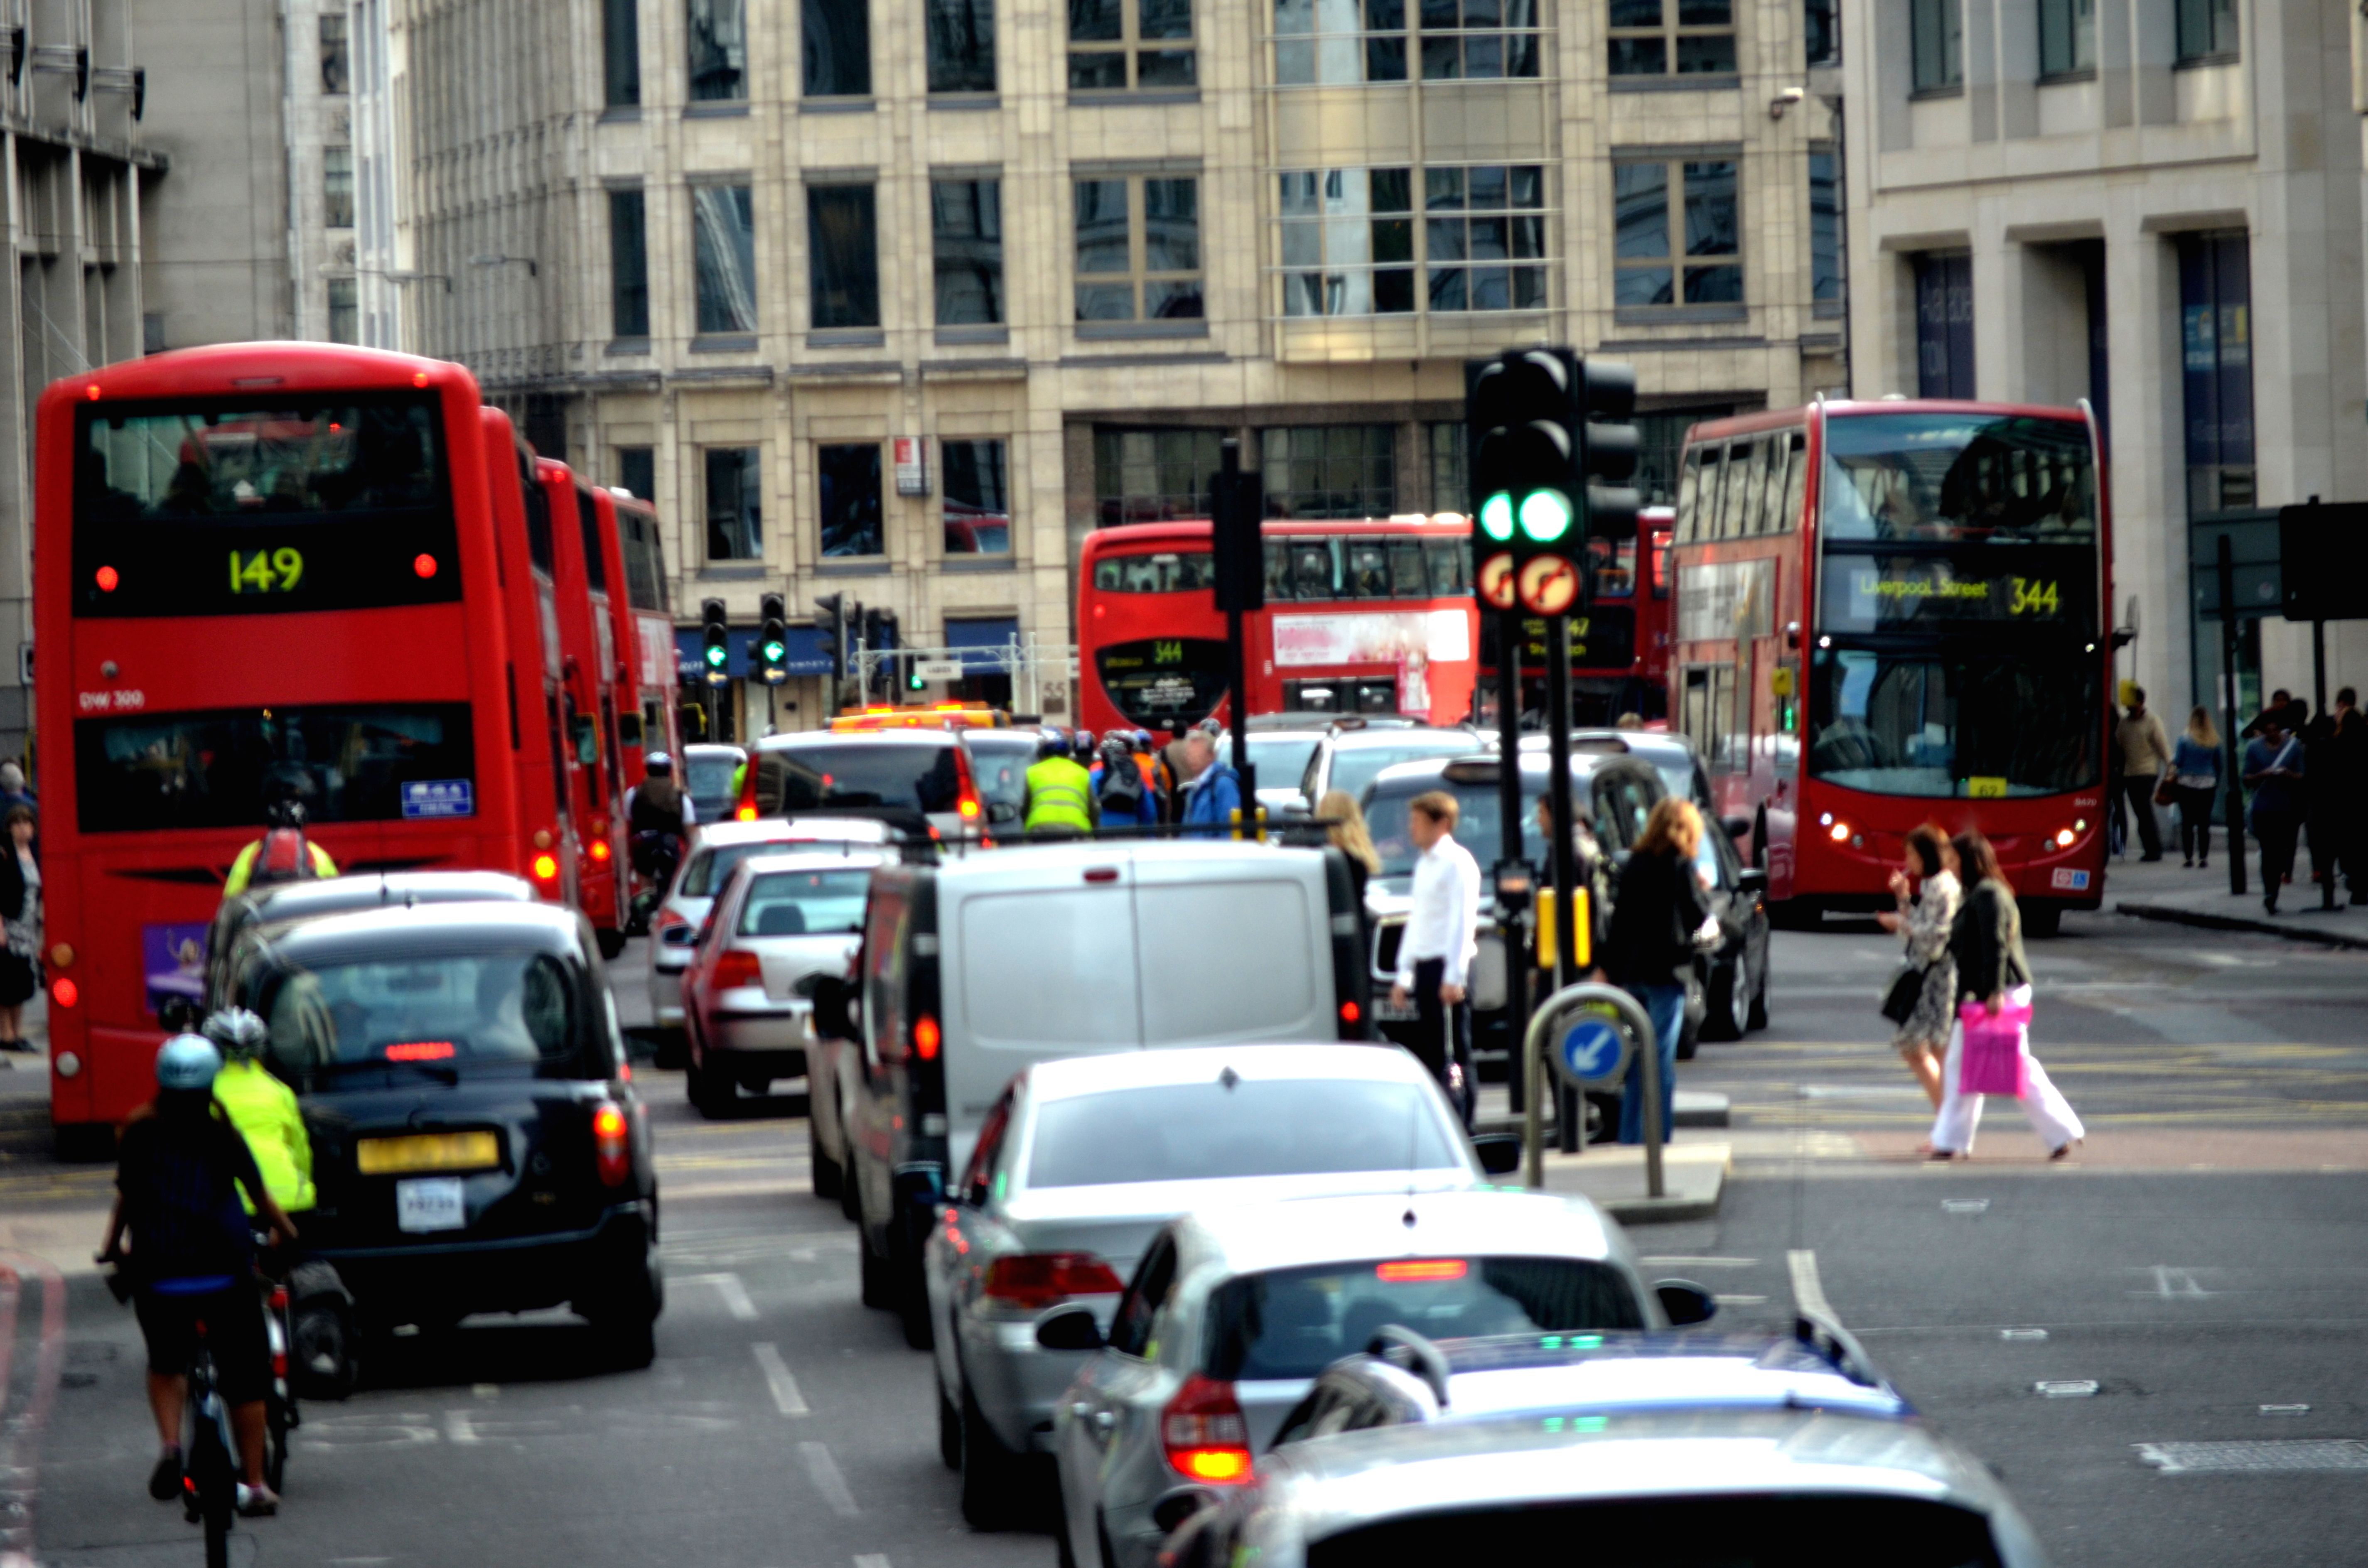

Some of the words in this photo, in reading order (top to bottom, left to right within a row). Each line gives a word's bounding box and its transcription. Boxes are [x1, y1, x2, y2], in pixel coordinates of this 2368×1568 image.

[230, 546, 303, 594] 149
[1860, 576, 1933, 601] Liverpool
[1938, 578, 1988, 598] Street
[2009, 577, 2058, 615] 344
[1154, 640, 1182, 664] 344
[113, 689, 145, 711] 300
[1044, 682, 1066, 698] 55
